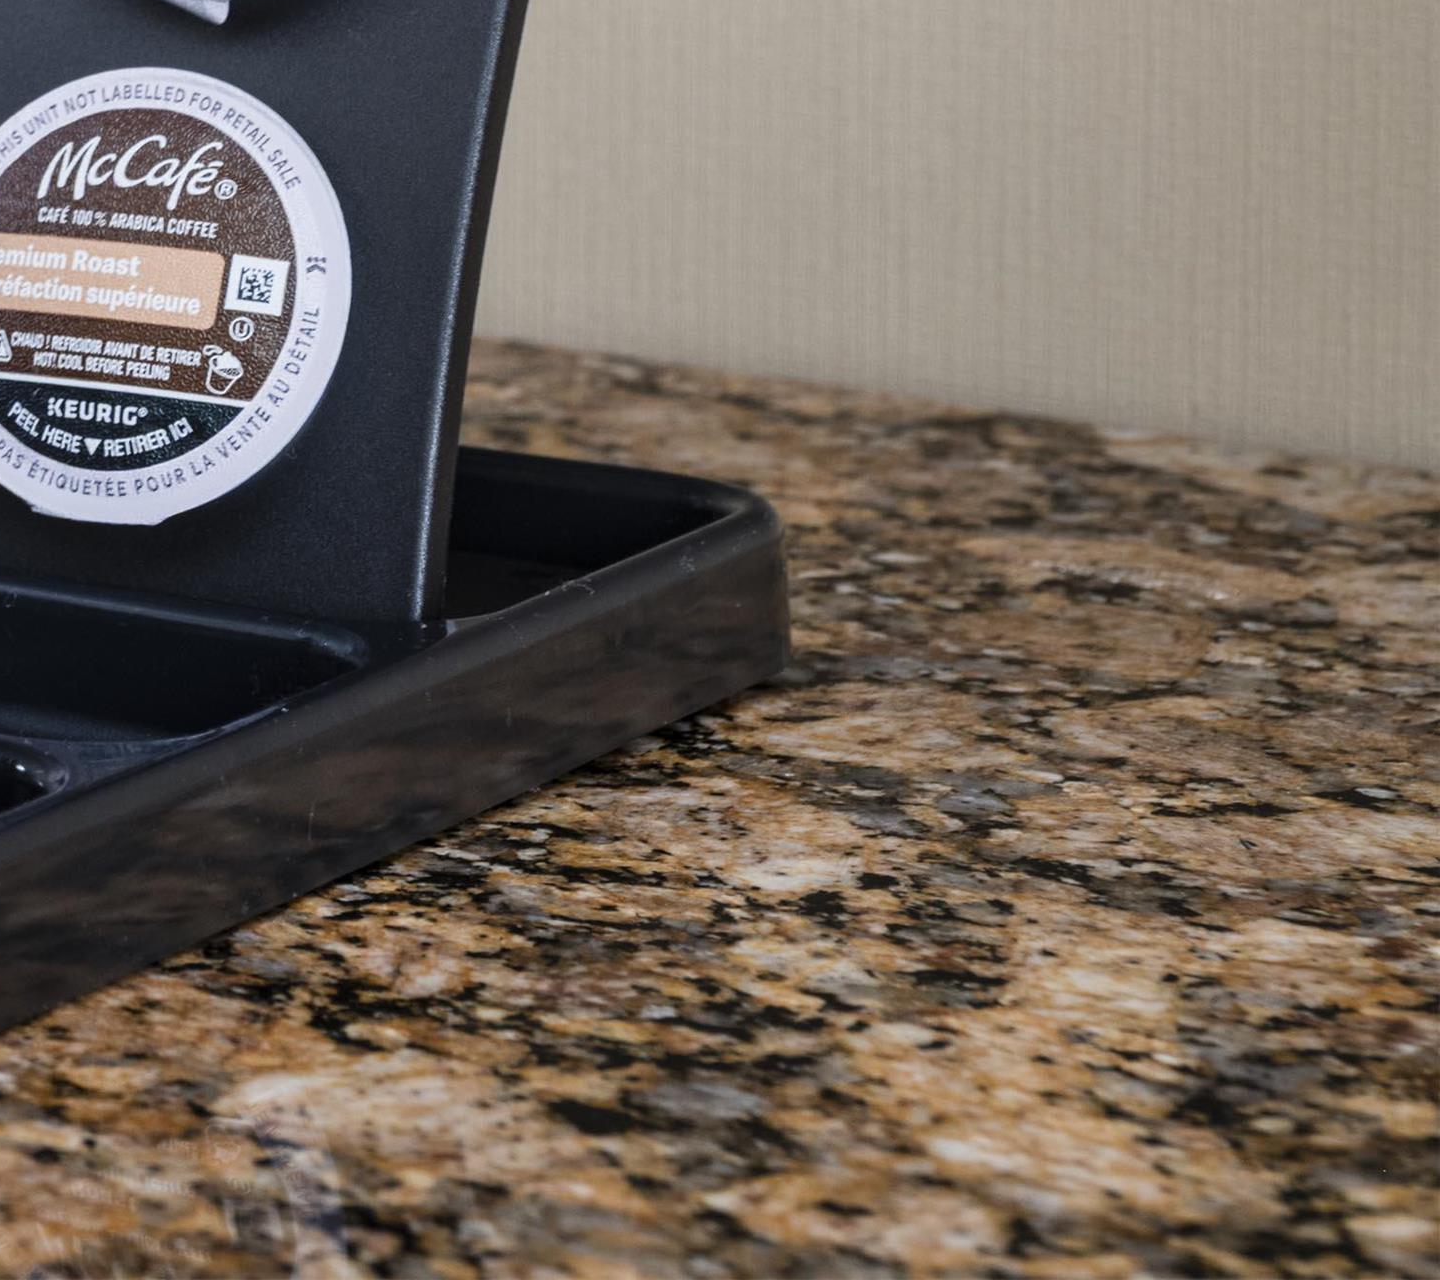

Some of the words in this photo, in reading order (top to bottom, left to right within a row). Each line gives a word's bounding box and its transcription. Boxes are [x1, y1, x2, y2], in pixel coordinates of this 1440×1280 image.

[22, 103, 60, 136] UNIT
[62, 89, 97, 115] NOT
[102, 82, 186, 104] LABELLED
[187, 91, 223, 116] FOR
[222, 107, 272, 153] RETAIL
[266, 148, 303, 191] SALE
[37, 204, 71, 225] CAFÉ
[109, 212, 166, 233] ARABICA
[166, 217, 220, 240] COFFEE
[70, 249, 143, 278] Roast
[84, 281, 202, 317] supérieure
[57, 353, 85, 371] COOL
[84, 354, 124, 374] BEFORE
[125, 361, 172, 382] PEELING
[103, 340, 139, 359] AVANT
[139, 345, 156, 362] DE
[156, 347, 203, 368] RETIRER
[26, 458, 128, 498] ÉTIQUETÉE
[133, 467, 188, 496] POUR
[188, 453, 216, 477] LA
[215, 405, 272, 461] VENTE
[267, 377, 292, 409] AU
[284, 305, 321, 377] DÉTAIL
[7, 400, 40, 438] PEEL
[41, 423, 84, 455] HERE
[103, 426, 172, 458] RETIRER
[169, 415, 195, 442] ICI
